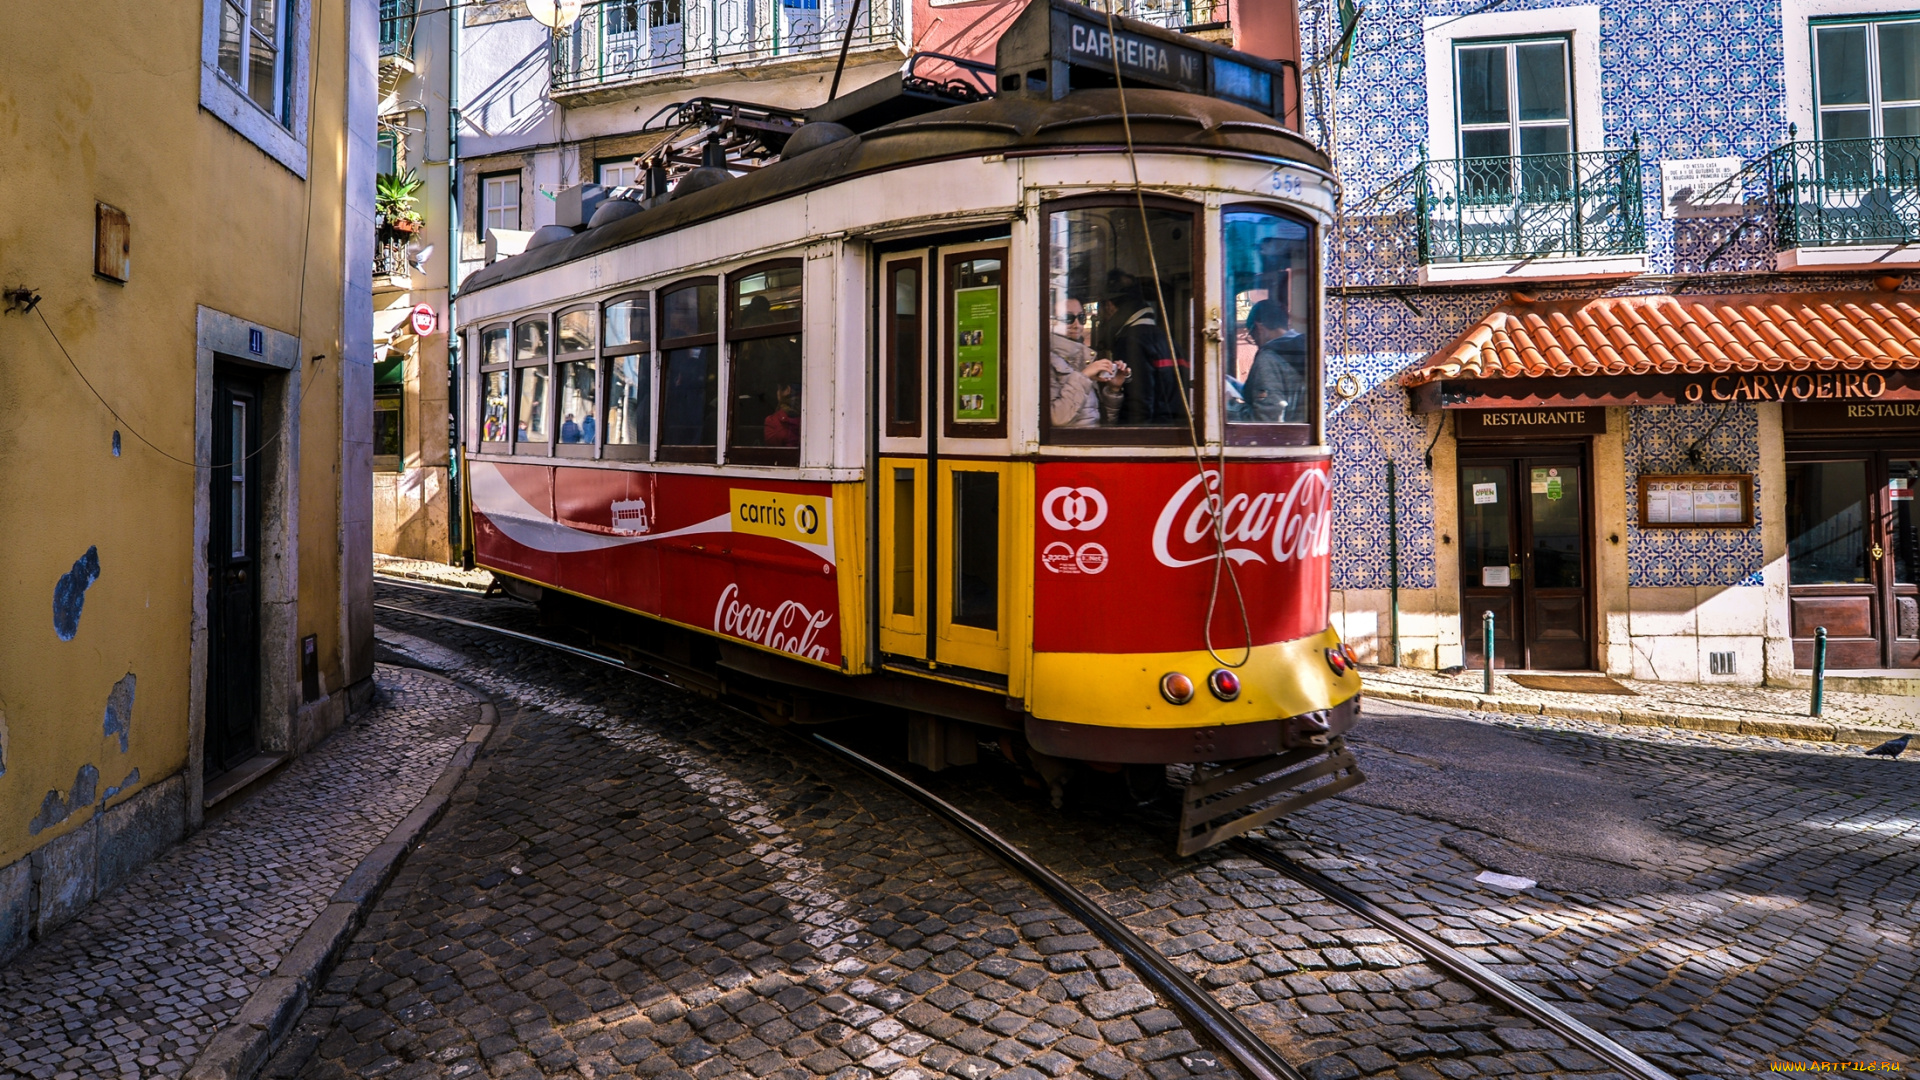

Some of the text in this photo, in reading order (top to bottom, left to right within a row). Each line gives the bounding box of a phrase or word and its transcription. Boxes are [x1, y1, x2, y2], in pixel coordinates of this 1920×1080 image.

[1072, 24, 1169, 74] CARREIRA
[1272, 172, 1302, 196] 558
[252, 331, 260, 352] 41
[1711, 373, 1886, 400] CARVOEIRO
[1483, 411, 1585, 426] RESTAURANTE
[740, 498, 786, 527] carris
[1152, 468, 1331, 568] Coca-Cola
[714, 583, 833, 661] Coca-Cola
